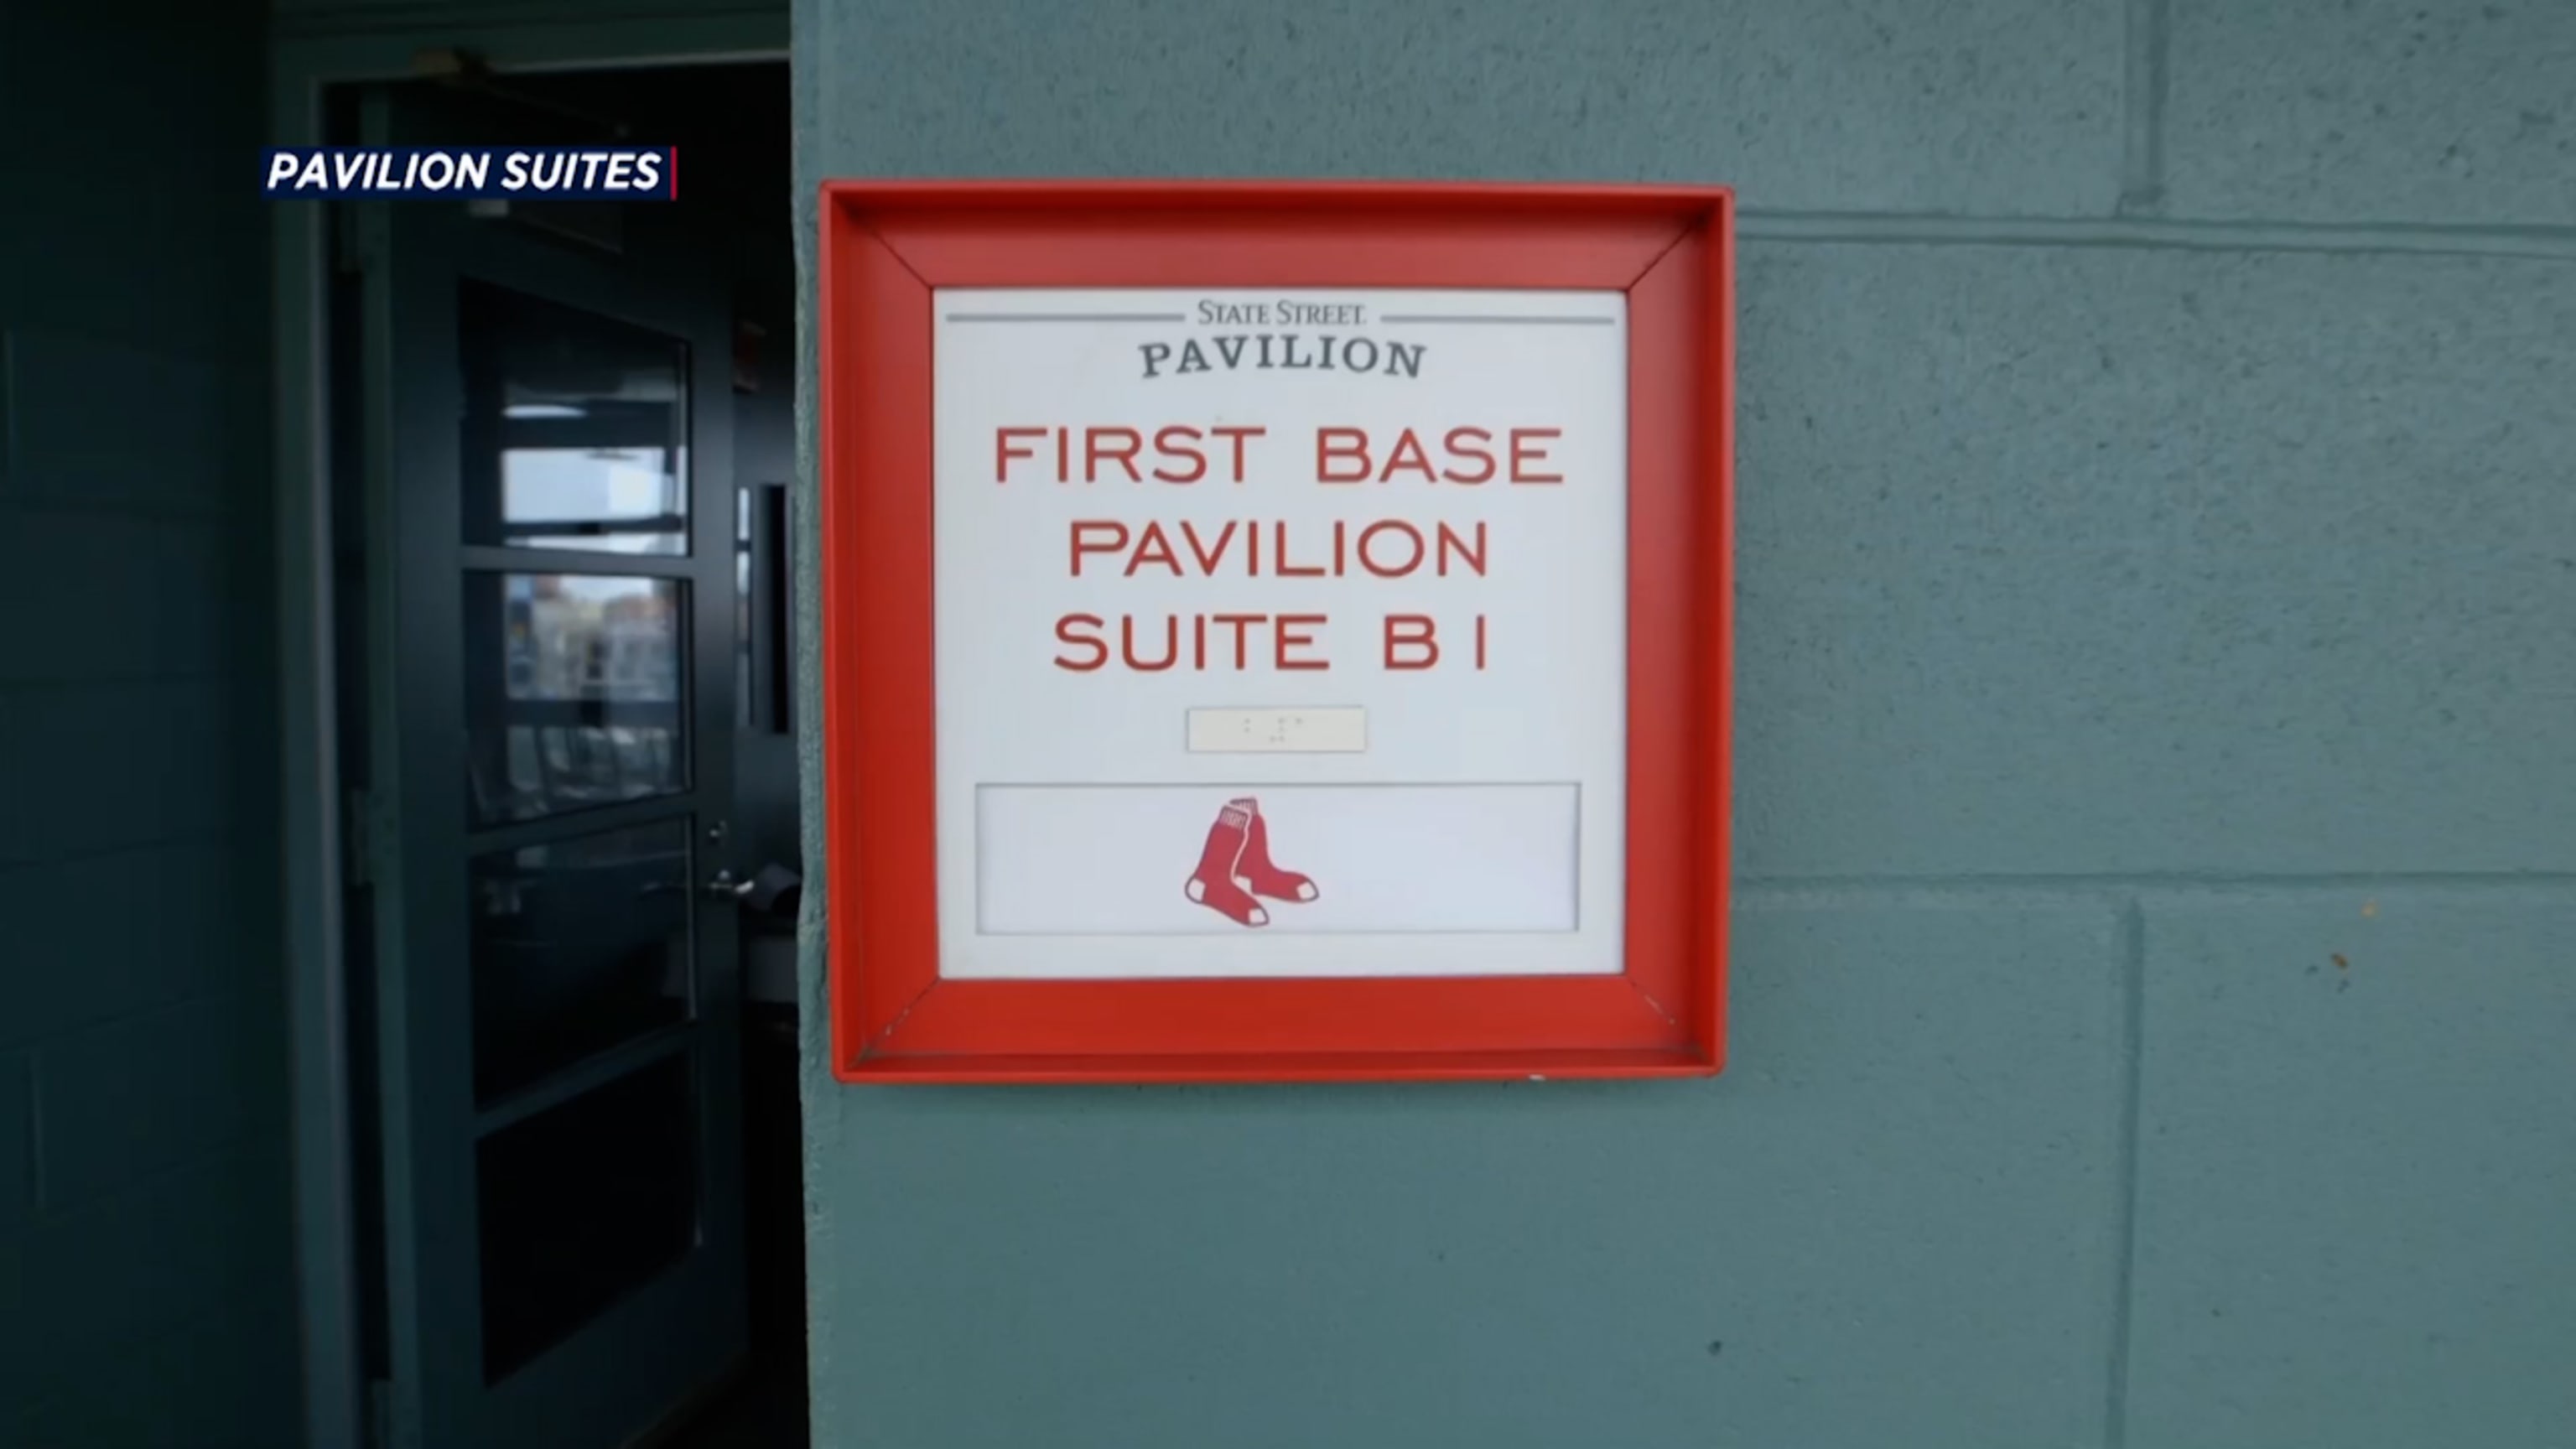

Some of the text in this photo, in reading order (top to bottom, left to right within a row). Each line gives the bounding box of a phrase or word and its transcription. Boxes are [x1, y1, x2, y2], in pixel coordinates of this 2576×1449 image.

[1197, 299, 1270, 325] STATE
[1137, 333, 1427, 379] PAVILION
[995, 425, 1564, 484] FIRST BASE
[1069, 520, 1488, 578] PAVILION
[1053, 612, 1330, 672] SUITE
